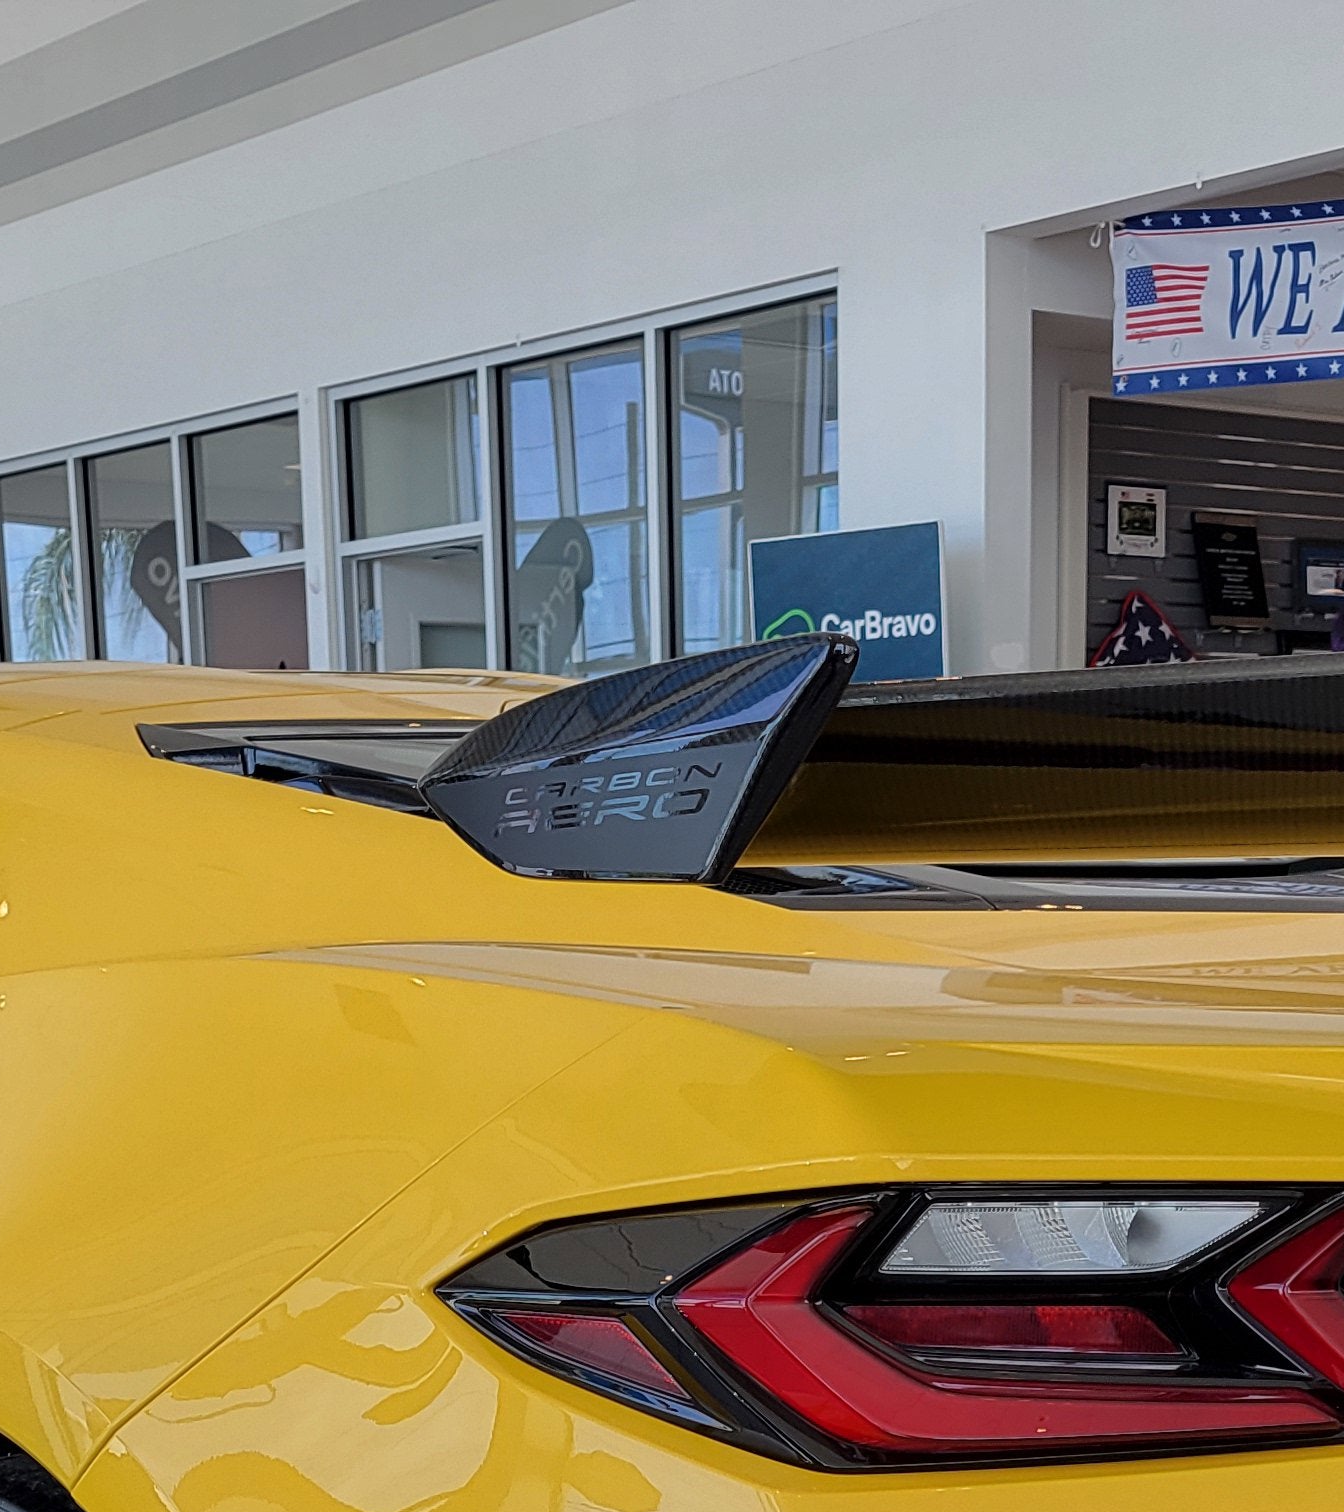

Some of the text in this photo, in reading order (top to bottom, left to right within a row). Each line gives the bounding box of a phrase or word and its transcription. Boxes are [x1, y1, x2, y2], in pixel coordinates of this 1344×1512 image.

[1227, 241, 1316, 340] WE
[820, 610, 936, 640] CarBravo
[505, 762, 722, 805] CARBON
[494, 788, 711, 838] AERO
